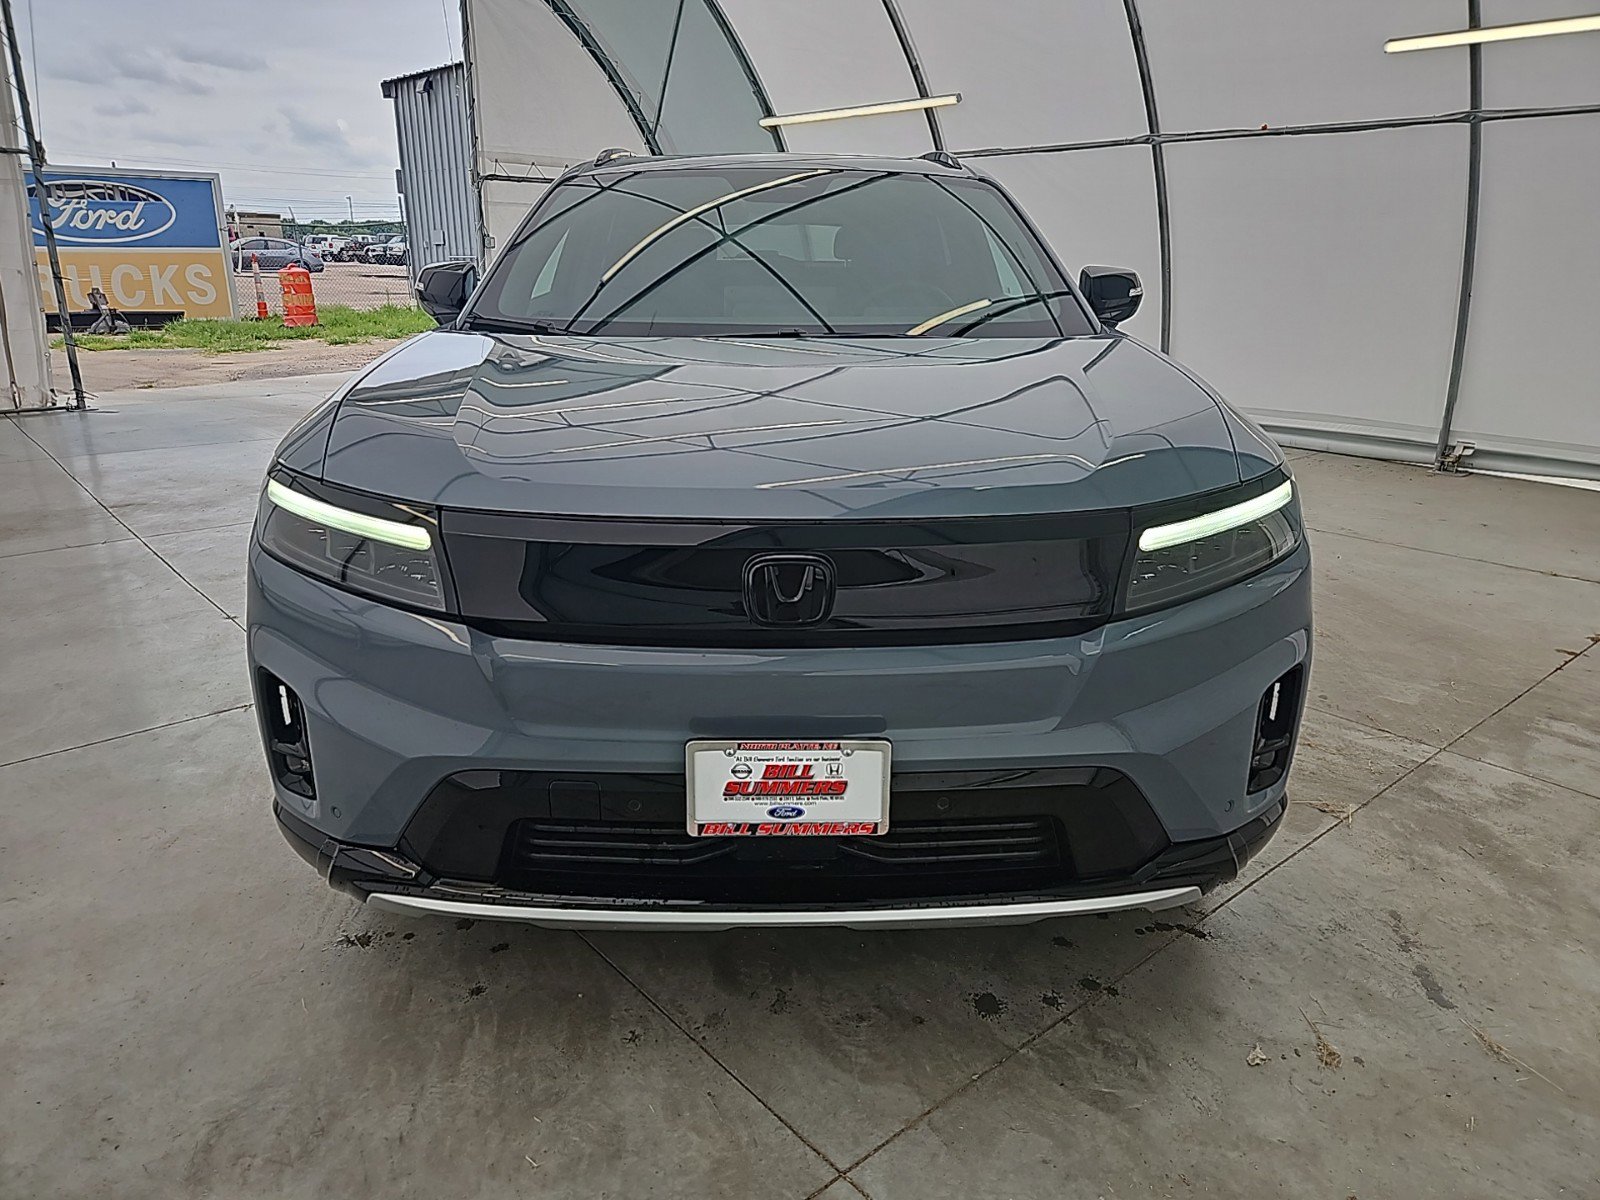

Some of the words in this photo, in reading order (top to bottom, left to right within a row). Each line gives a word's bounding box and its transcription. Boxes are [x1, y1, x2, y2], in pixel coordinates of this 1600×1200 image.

[40, 189, 145, 231] Ford
[761, 764, 815, 779] BILL
[723, 781, 848, 796] SUMMERS
[774, 807, 798, 817] Ford
[701, 822, 752, 835] BILL
[756, 822, 876, 835] SUMMERS
